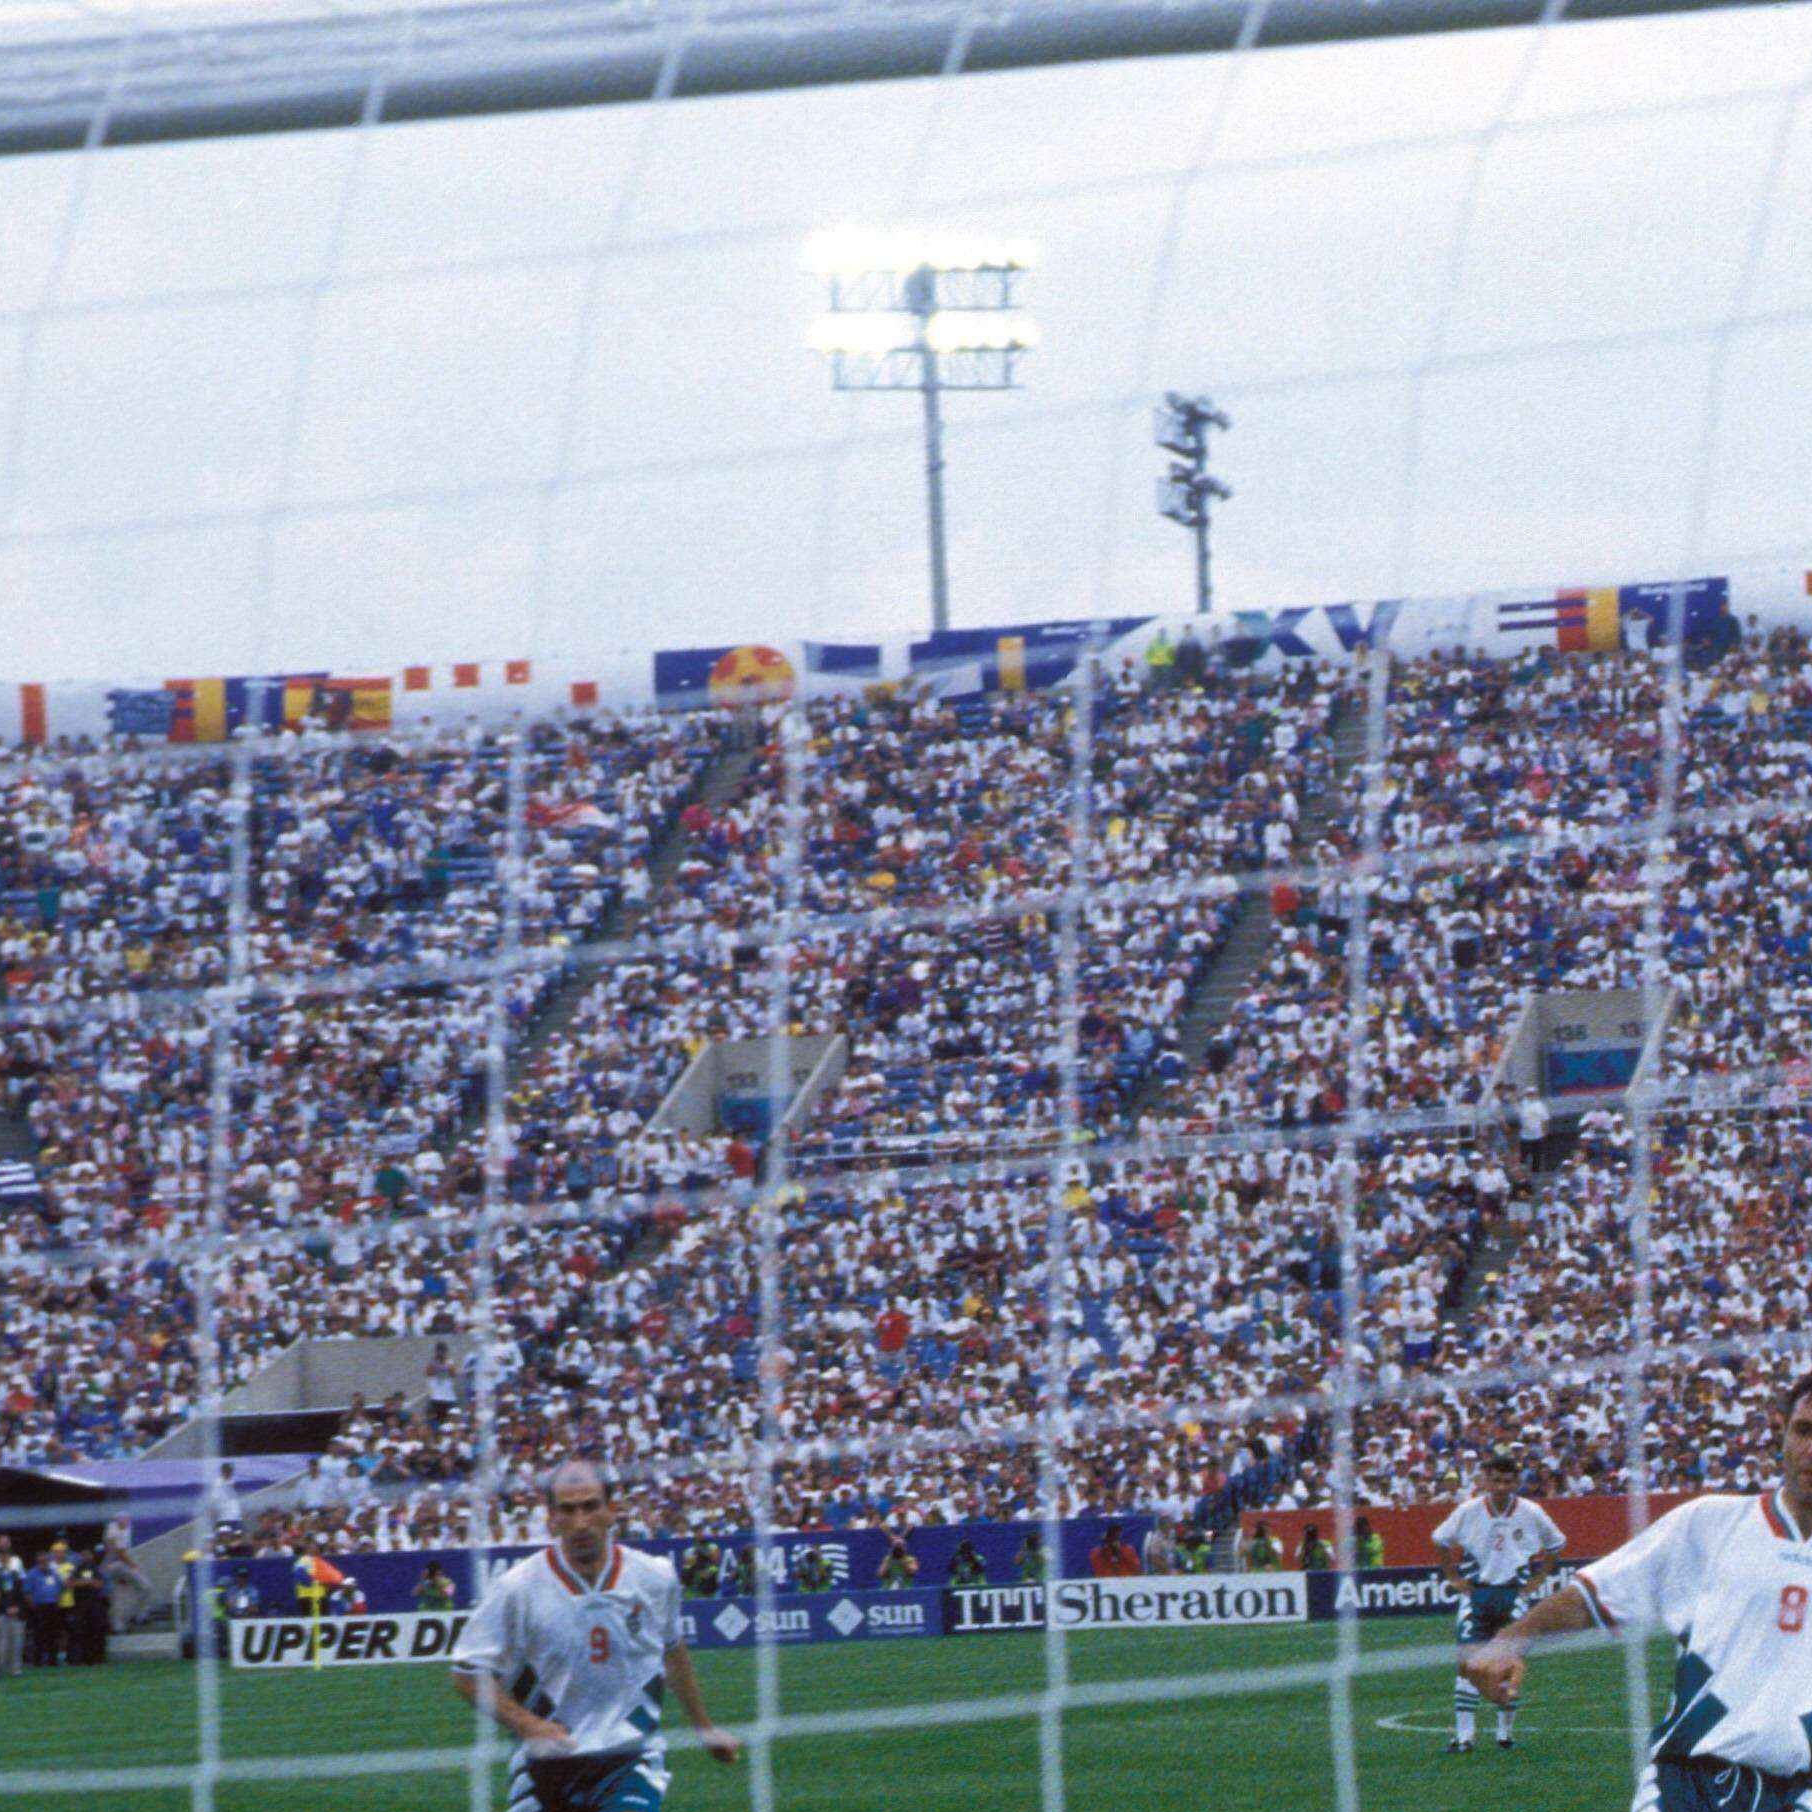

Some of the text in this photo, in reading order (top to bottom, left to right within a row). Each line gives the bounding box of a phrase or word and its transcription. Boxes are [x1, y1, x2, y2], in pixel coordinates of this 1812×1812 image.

[1053, 1577, 1297, 1625] Sheraton
[1334, 1571, 1461, 1611] Americ
[1778, 1585, 1808, 1633] 8
[753, 1605, 811, 1634] sun
[868, 1600, 925, 1628] sun
[242, 1618, 401, 1664] UPPER
[589, 1625, 611, 1664] 9
